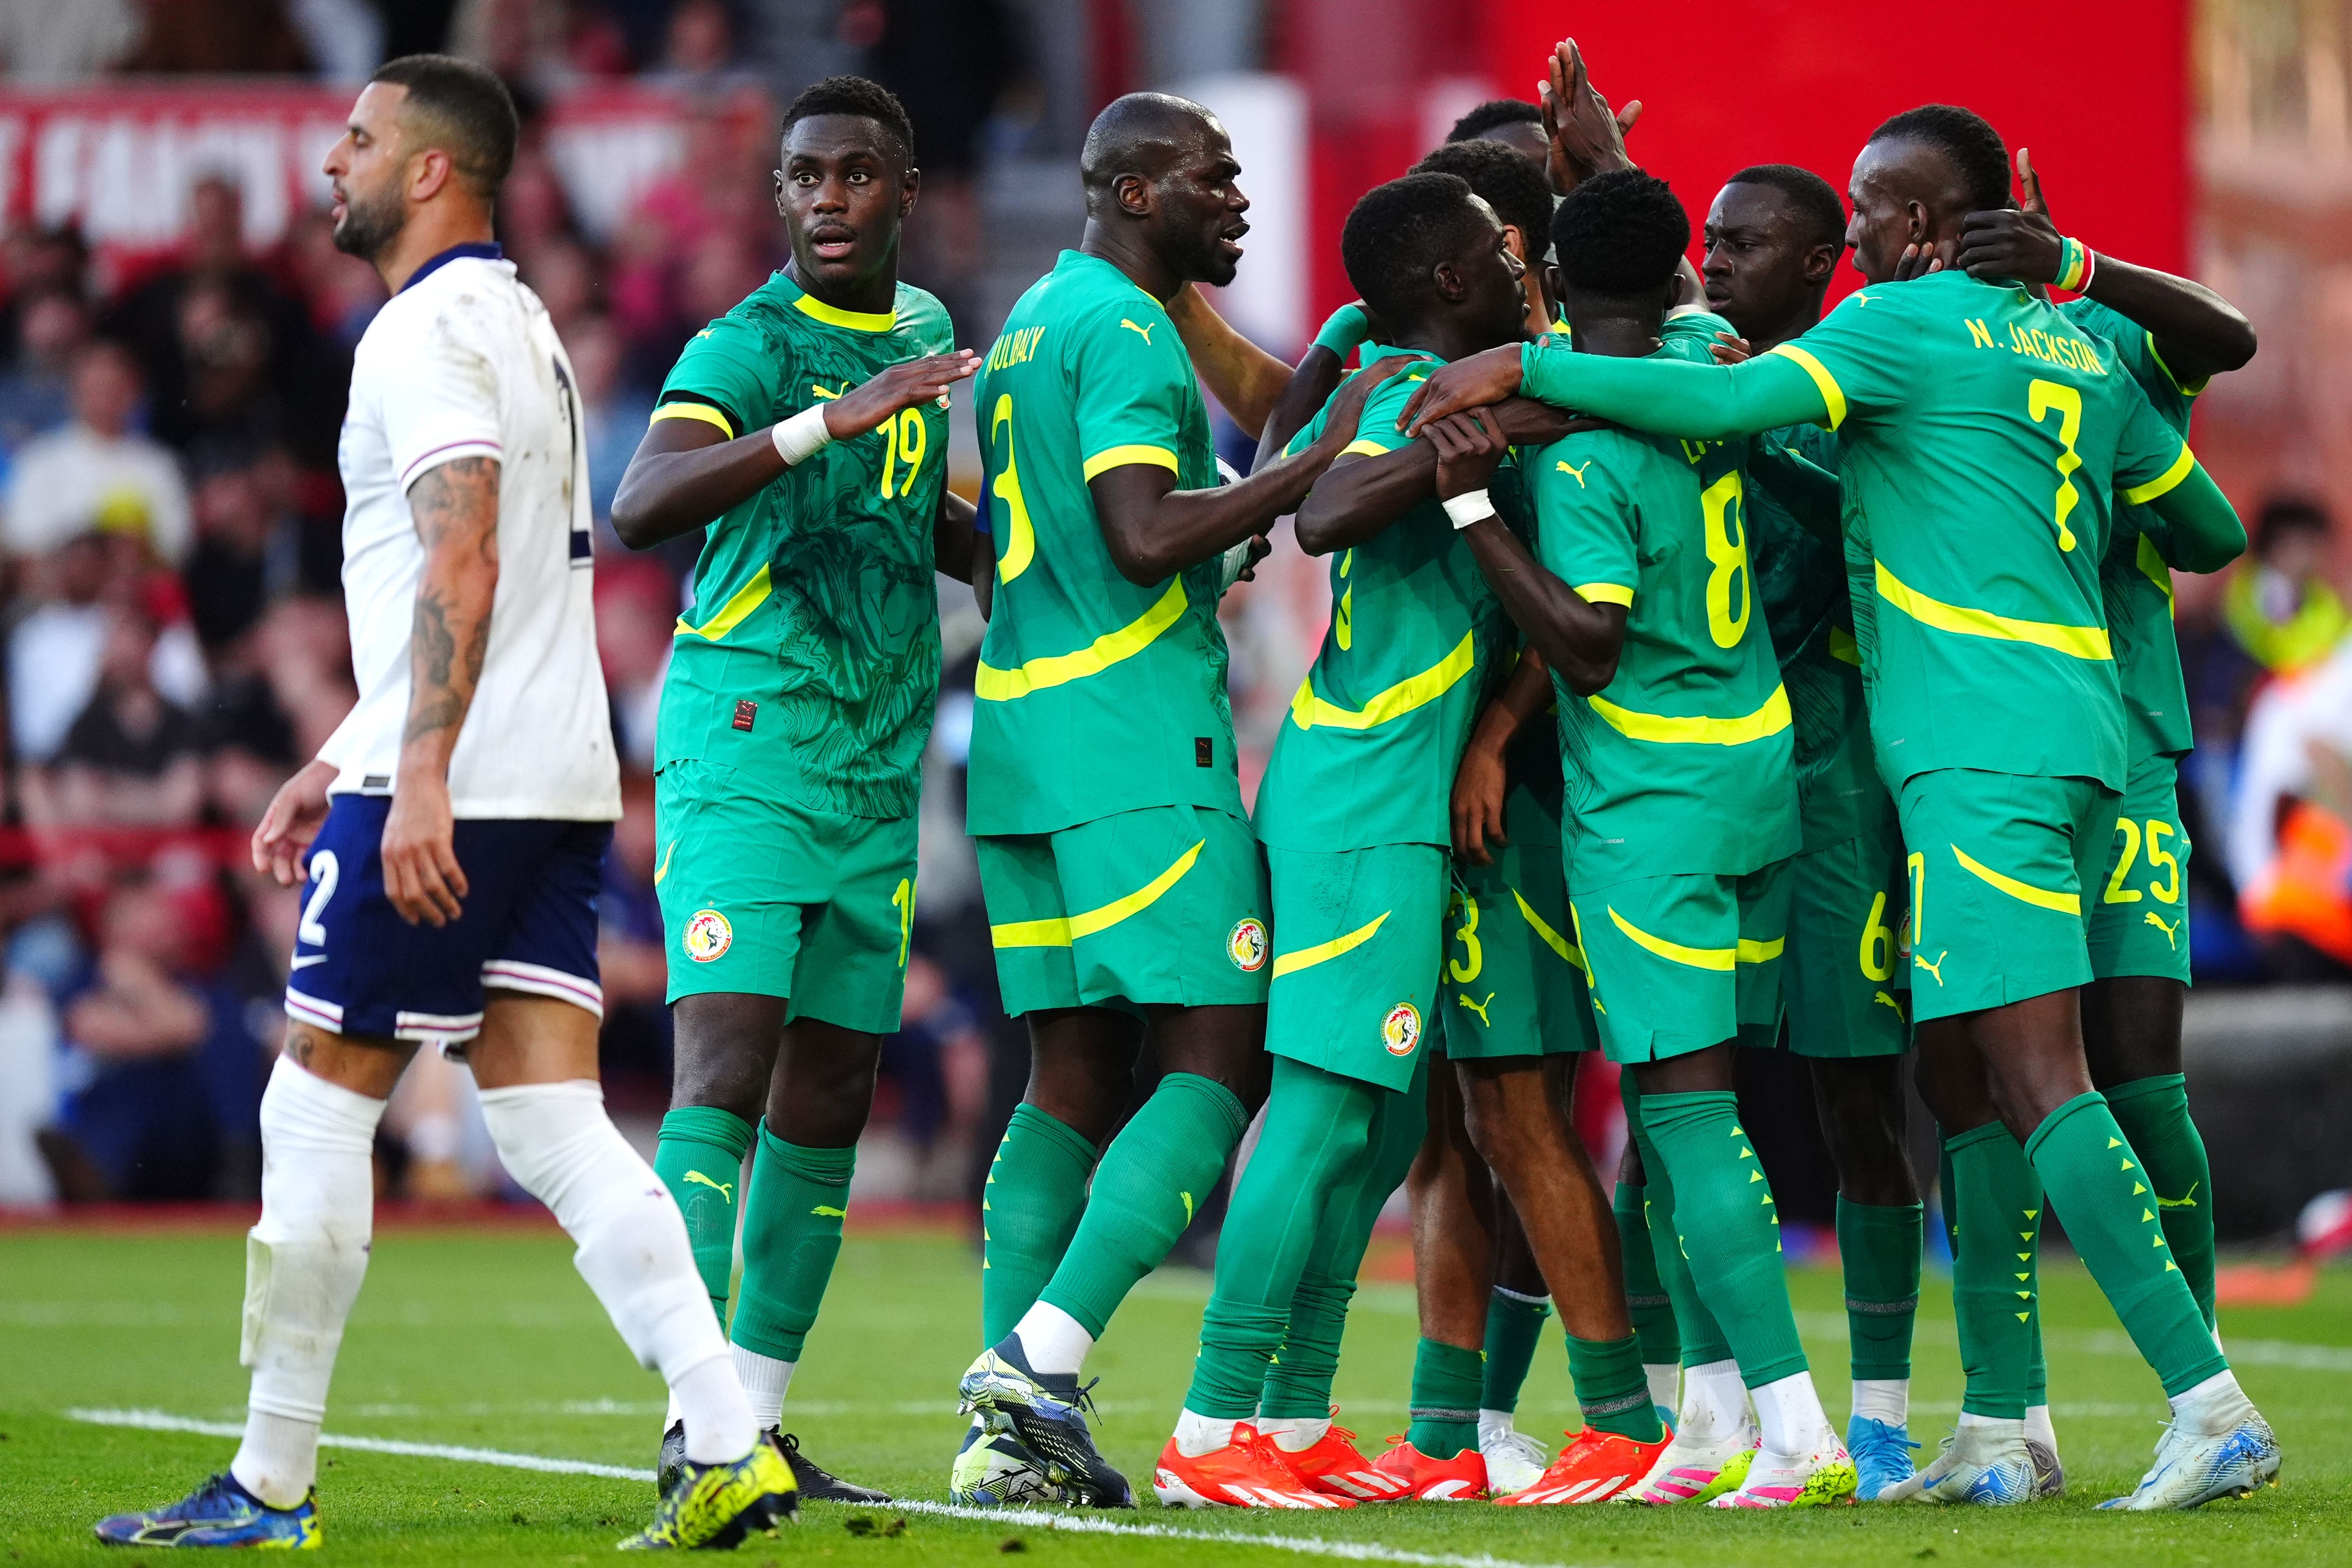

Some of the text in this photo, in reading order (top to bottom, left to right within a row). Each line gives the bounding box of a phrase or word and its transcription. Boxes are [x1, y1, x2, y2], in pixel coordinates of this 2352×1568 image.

[1964, 318, 2108, 375] N. JACKSON
[876, 408, 926, 499] 19
[2028, 379, 2082, 552] 7
[1701, 469, 1750, 649] 8
[297, 848, 340, 947] 2
[1907, 852, 1925, 945] 7
[2104, 818, 2181, 904] 25
[1859, 891, 1894, 982] 6
